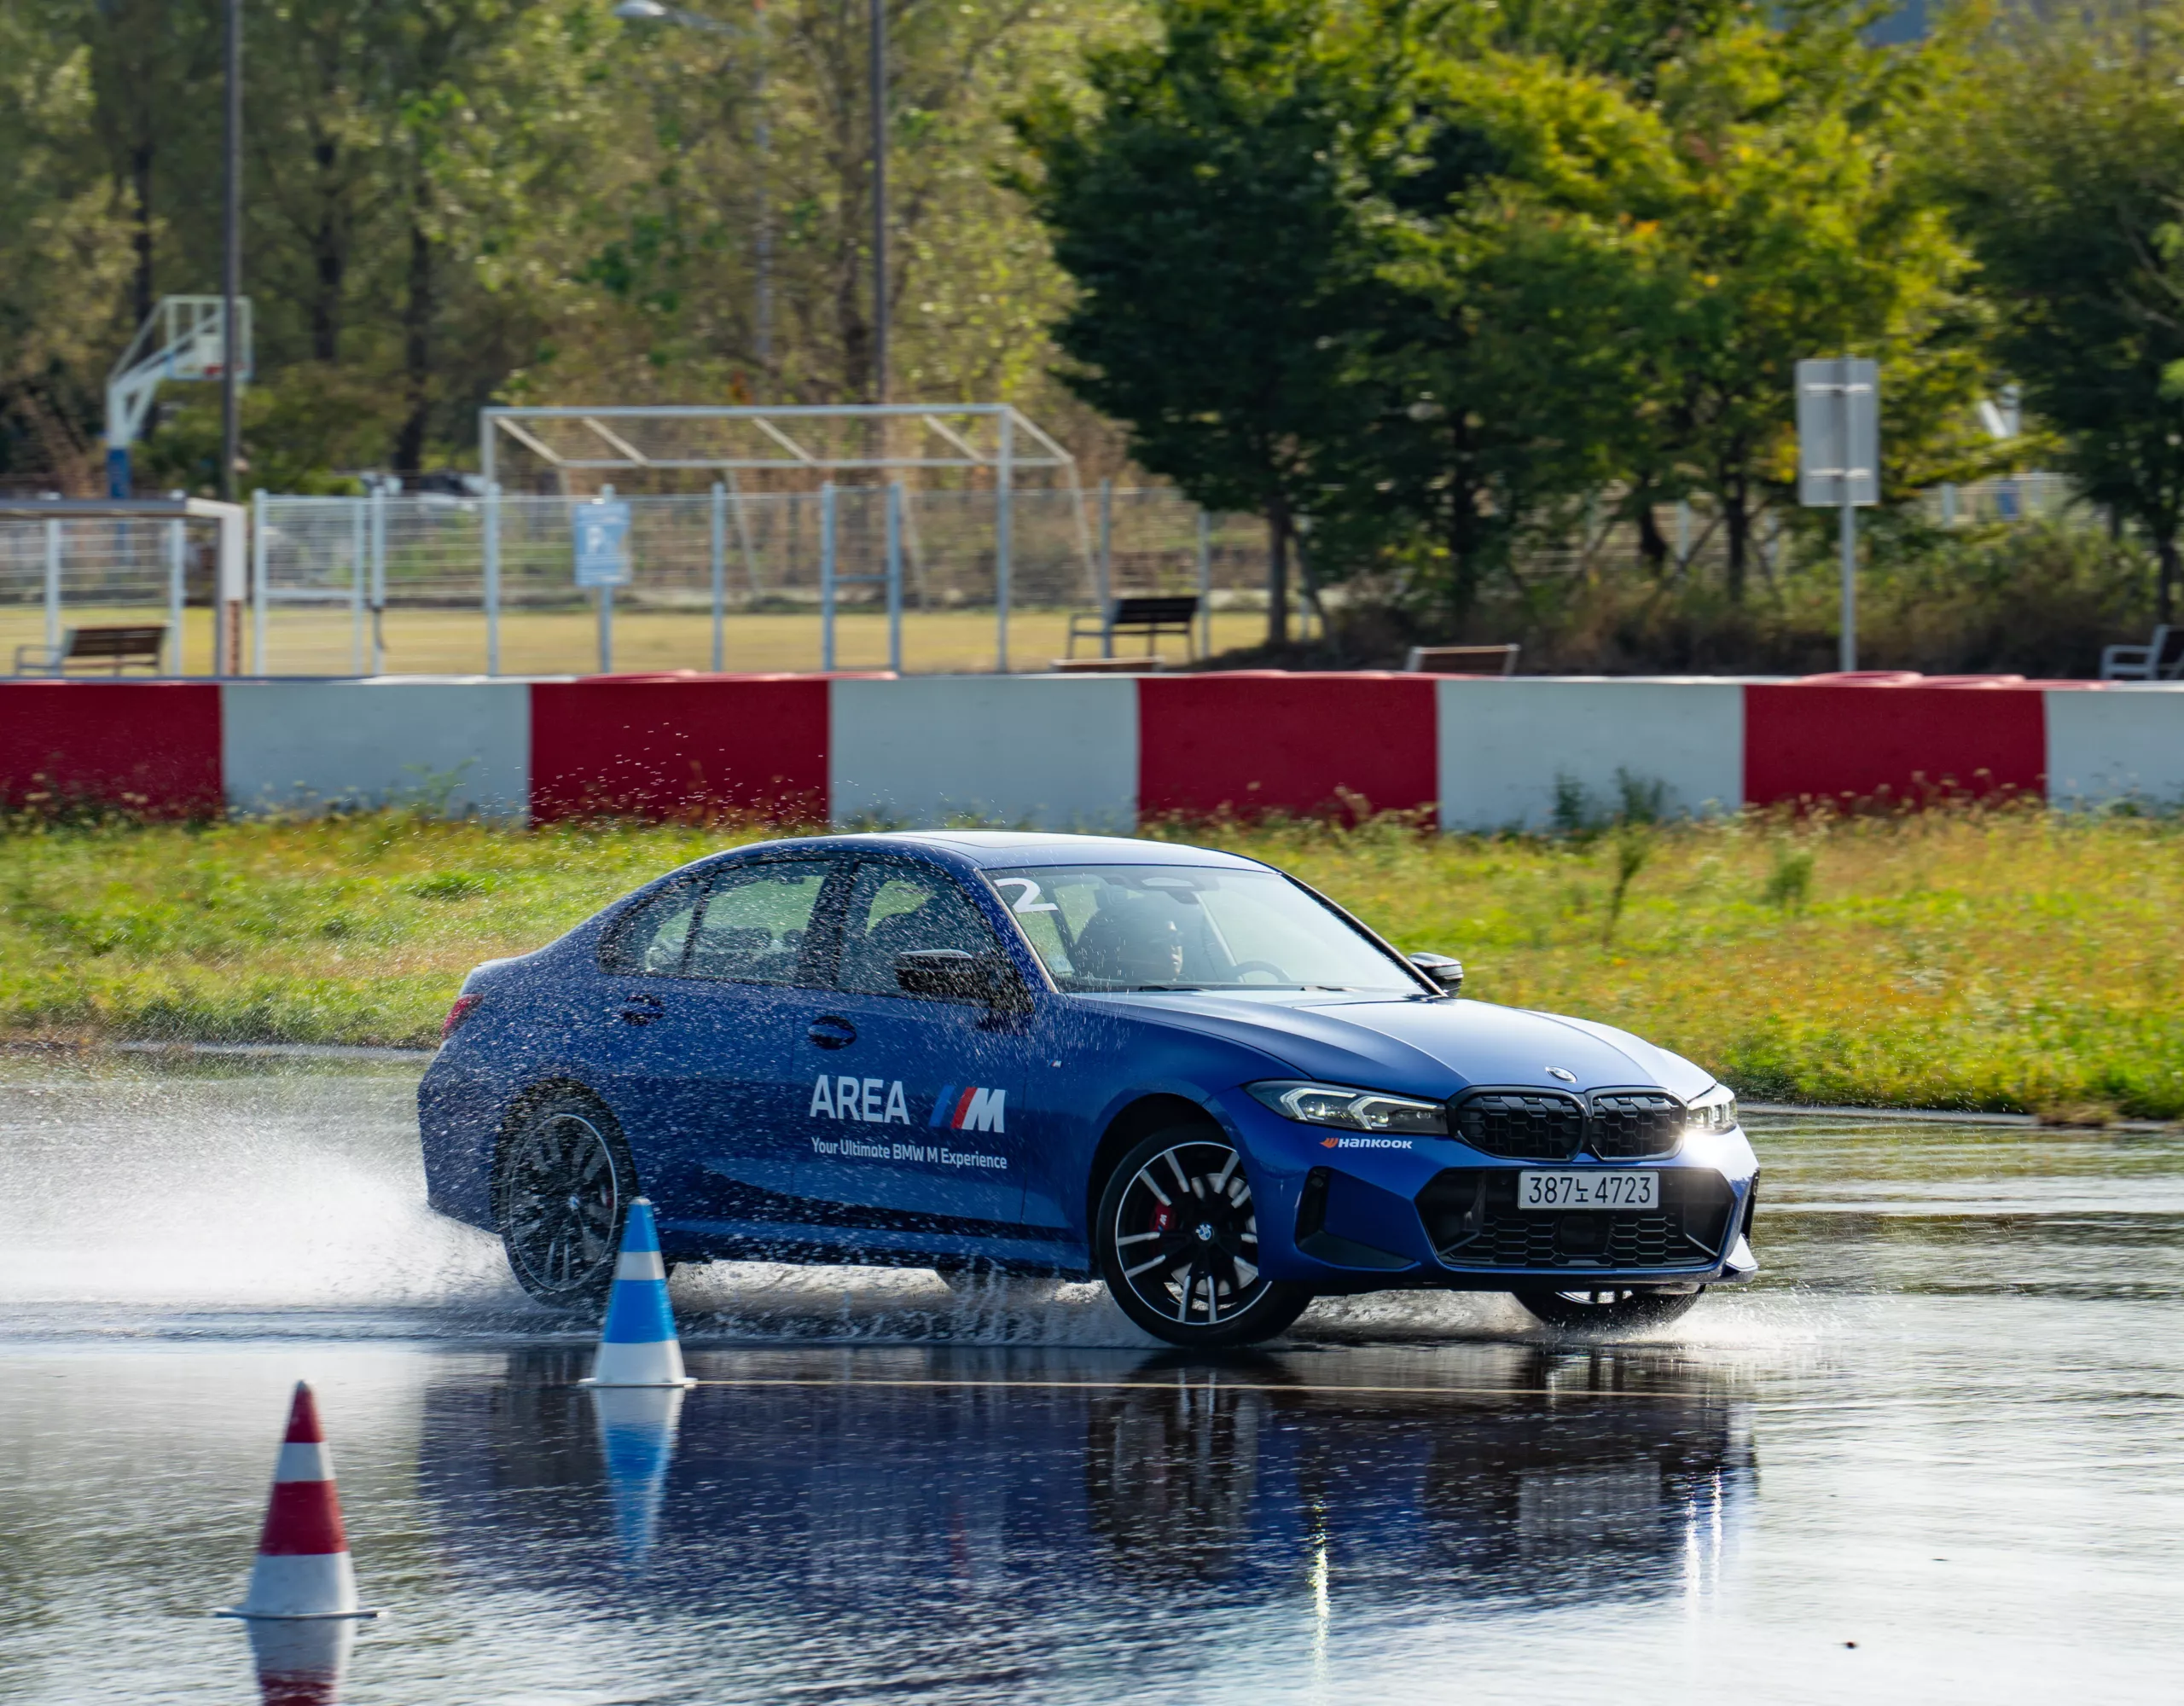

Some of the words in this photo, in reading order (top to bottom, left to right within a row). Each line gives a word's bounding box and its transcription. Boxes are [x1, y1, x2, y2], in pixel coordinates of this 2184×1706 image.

[993, 878, 1058, 913] 2
[810, 1075, 910, 1125] AREA
[811, 1137, 839, 1154] Your
[839, 1139, 890, 1158] Ultimate
[892, 1143, 924, 1162] BMW
[926, 1146, 938, 1163] M
[940, 1147, 1008, 1169] Experience
